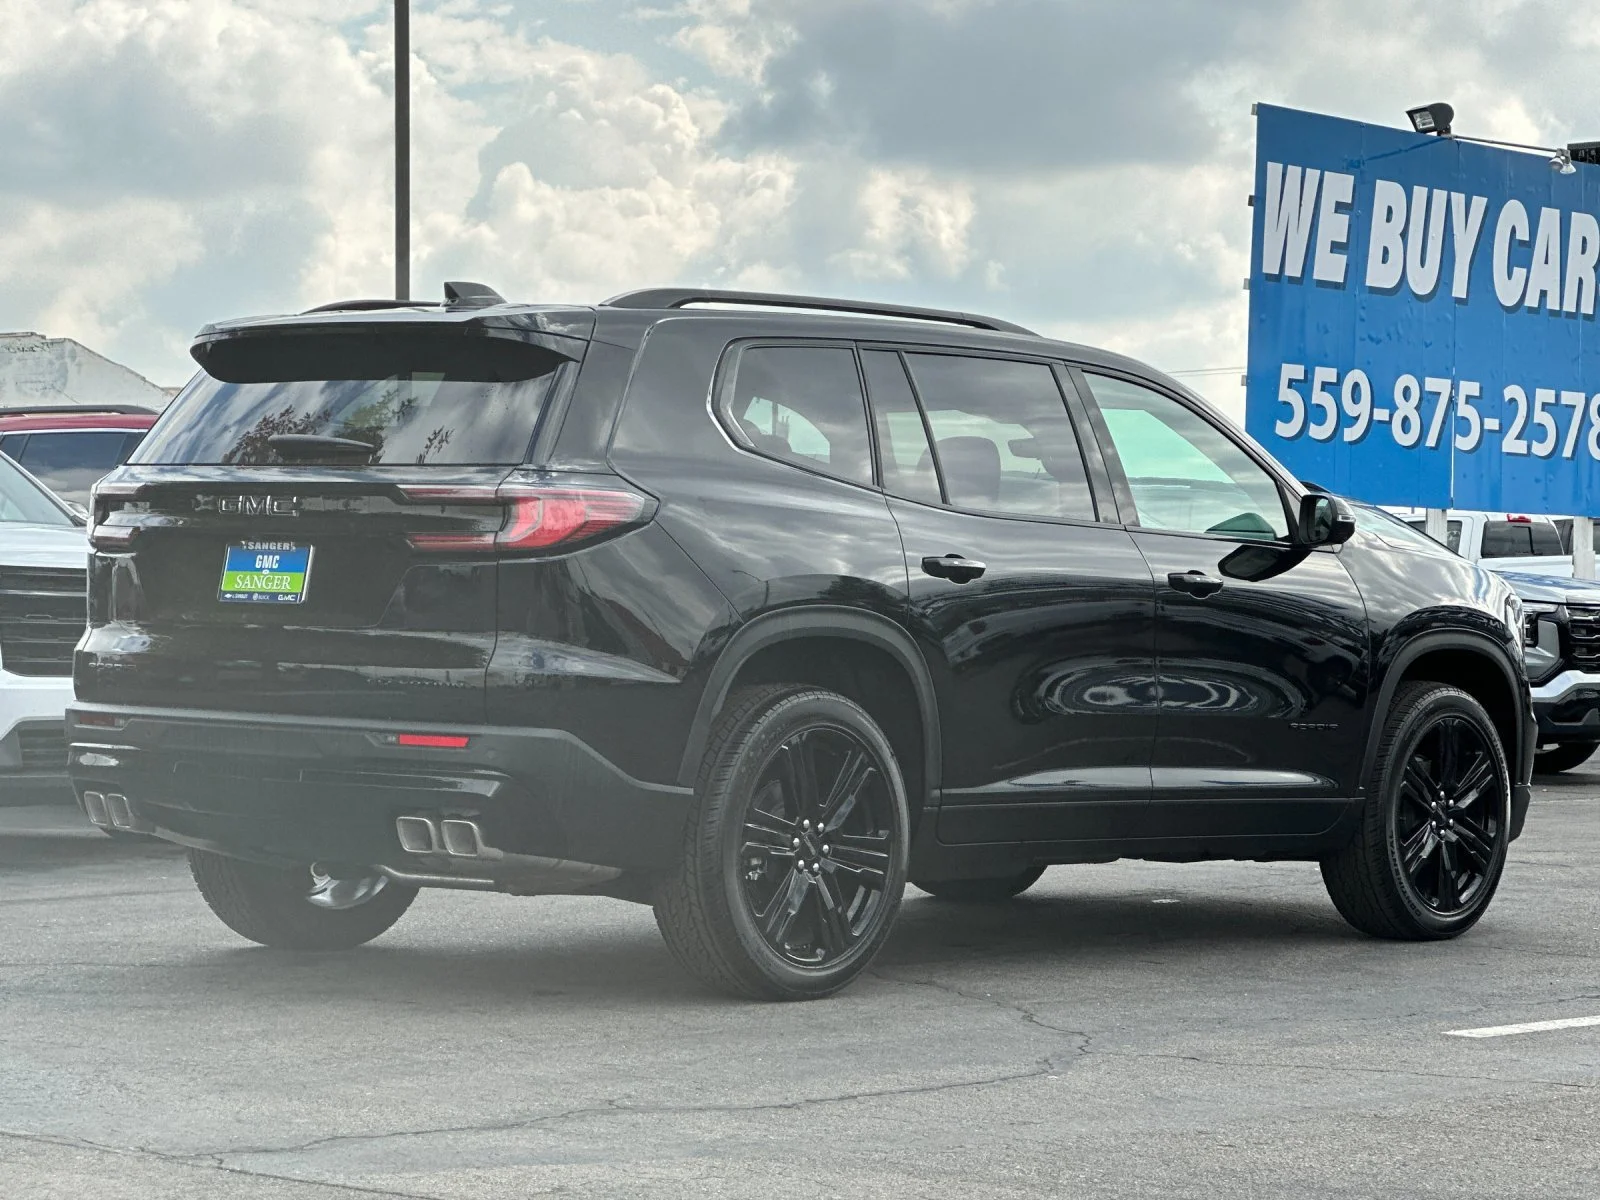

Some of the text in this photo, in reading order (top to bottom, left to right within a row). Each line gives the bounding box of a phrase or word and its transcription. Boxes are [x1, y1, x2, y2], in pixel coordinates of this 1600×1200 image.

[1262, 161, 1600, 315] WE BUY CAR
[219, 495, 299, 516] GMC
[247, 541, 289, 551] SANGER
[255, 555, 280, 569] GMC
[234, 574, 292, 590] SANGER
